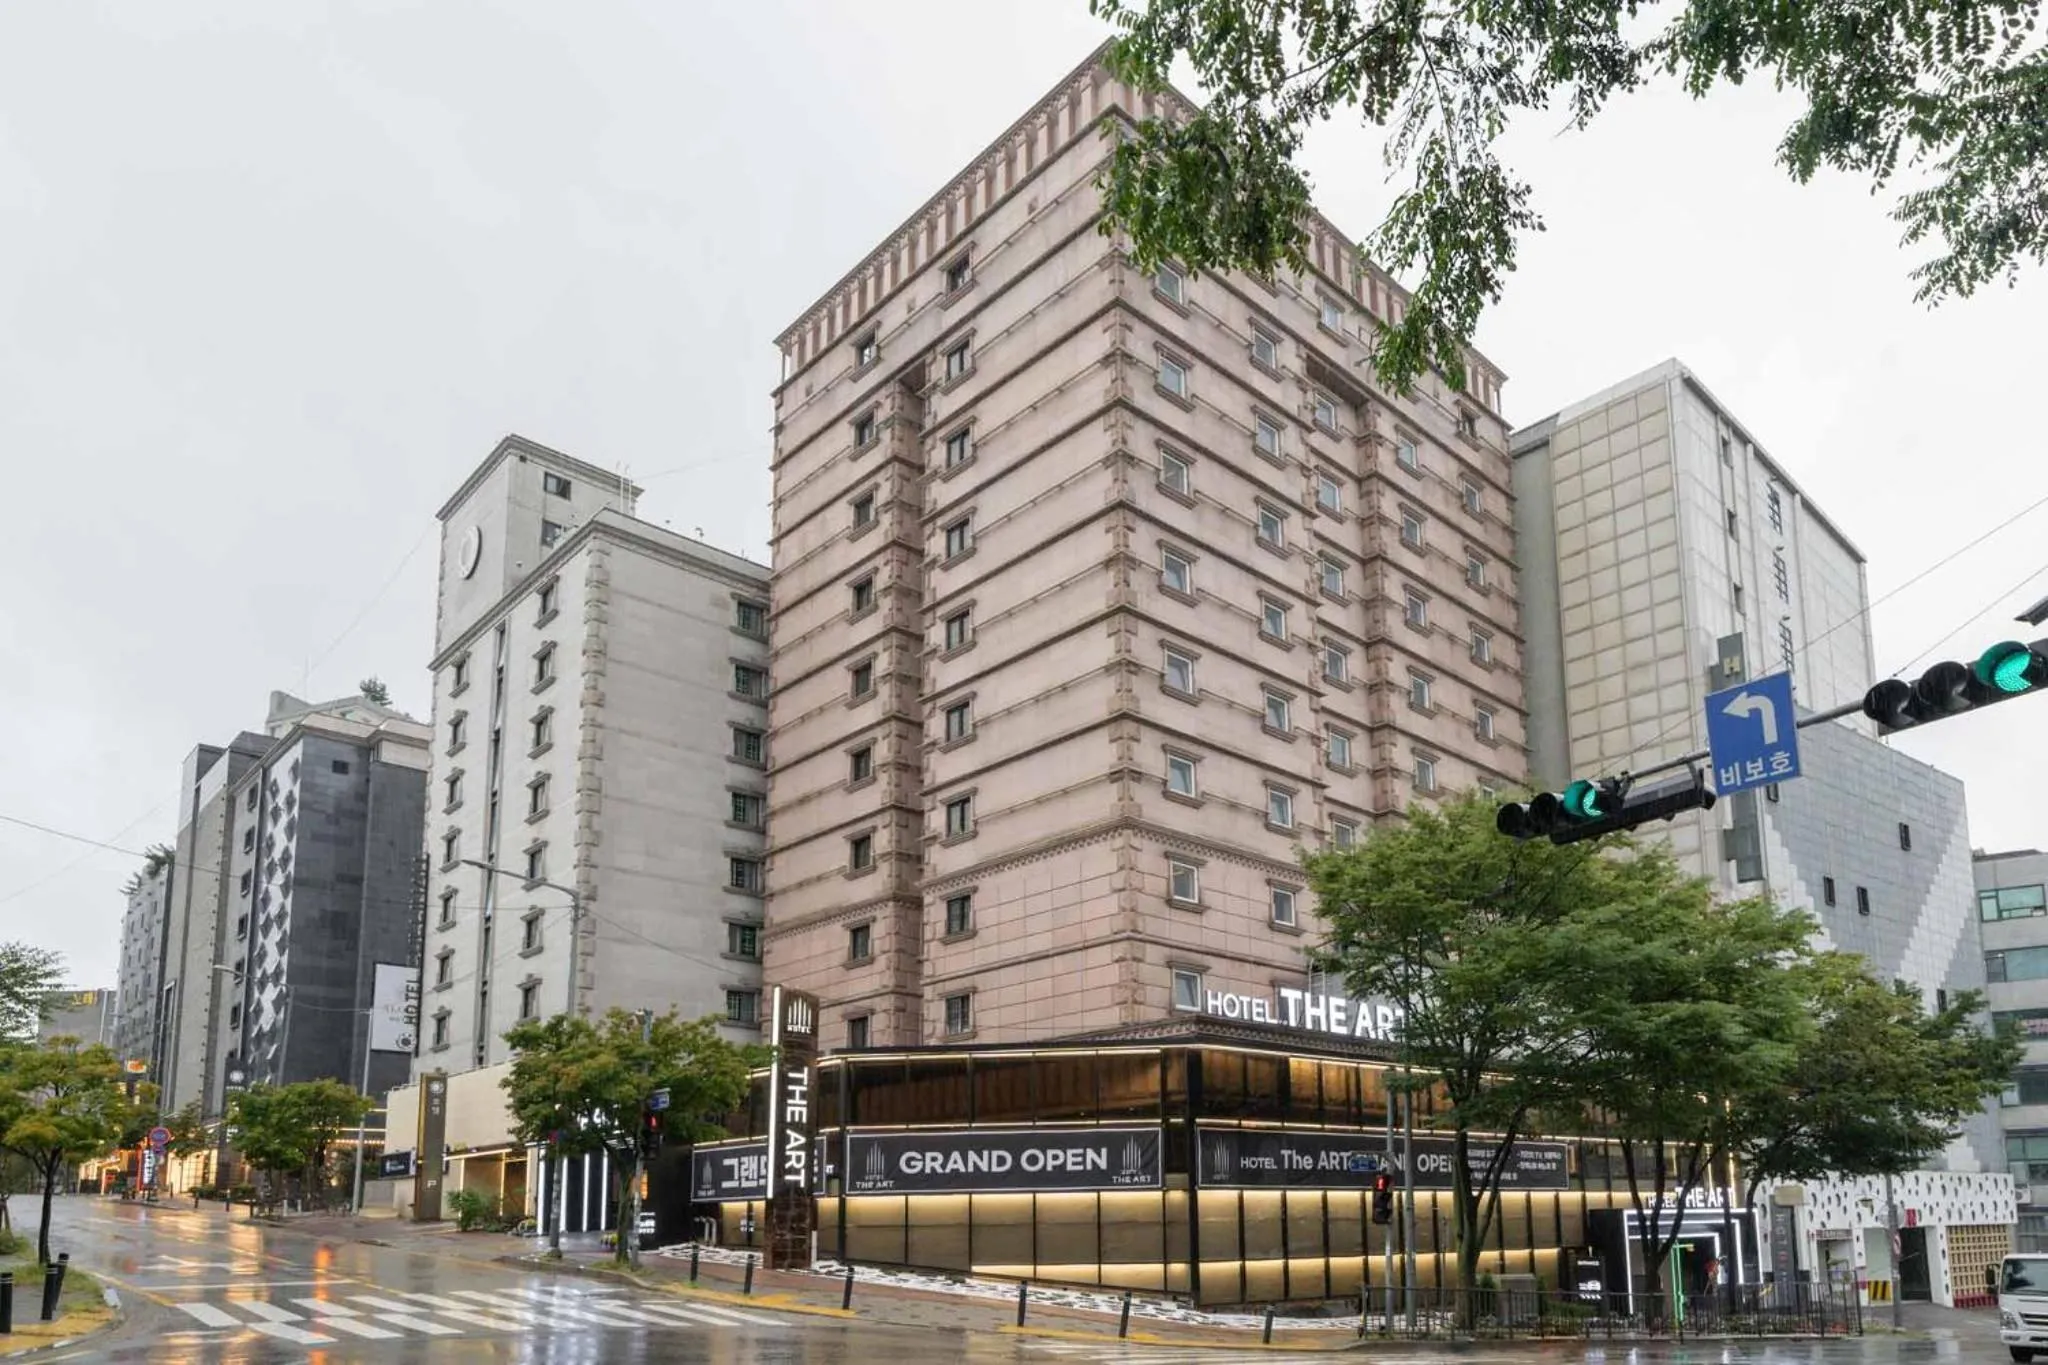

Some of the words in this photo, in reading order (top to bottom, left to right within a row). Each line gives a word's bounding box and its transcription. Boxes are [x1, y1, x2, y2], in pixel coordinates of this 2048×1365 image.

[1720, 751, 1793, 786] 비보호
[404, 979, 419, 1024] HOTEL
[1205, 990, 1278, 1024] HOTEL
[1280, 987, 1347, 1034] THE
[786, 1066, 808, 1123] THE
[784, 1129, 806, 1188] ART
[899, 1150, 1012, 1174] GRAND
[1020, 1147, 1107, 1172] OPEN
[1240, 1156, 1277, 1169] HOTEL
[1281, 1150, 1314, 1169] The
[1318, 1151, 1352, 1171] ART
[856, 1181, 874, 1189] THE
[876, 1180, 894, 1188] ART
[1133, 1175, 1151, 1183] ART
